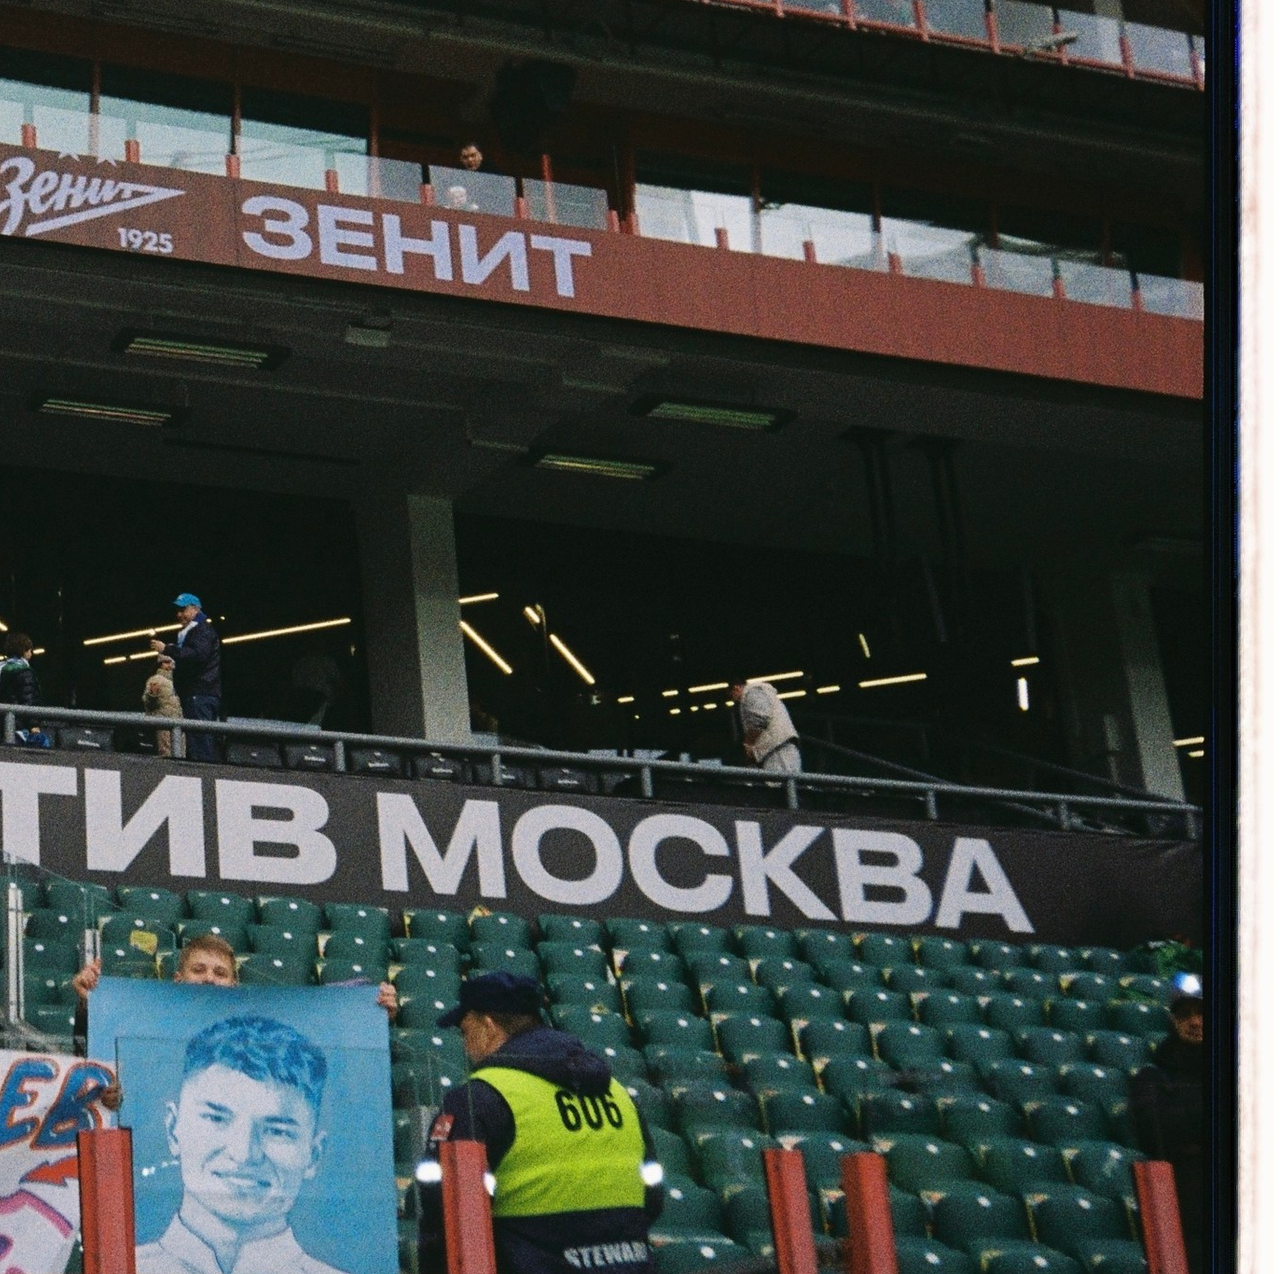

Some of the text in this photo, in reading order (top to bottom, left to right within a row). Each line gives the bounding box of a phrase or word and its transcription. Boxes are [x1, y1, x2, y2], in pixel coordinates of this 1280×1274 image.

[117, 227, 173, 254] 1925
[241, 194, 593, 299] ЗЕНИТ
[376, 789, 1037, 934] МОСКВА
[555, 1090, 624, 1132] 606
[563, 1240, 649, 1269] STEWAR
